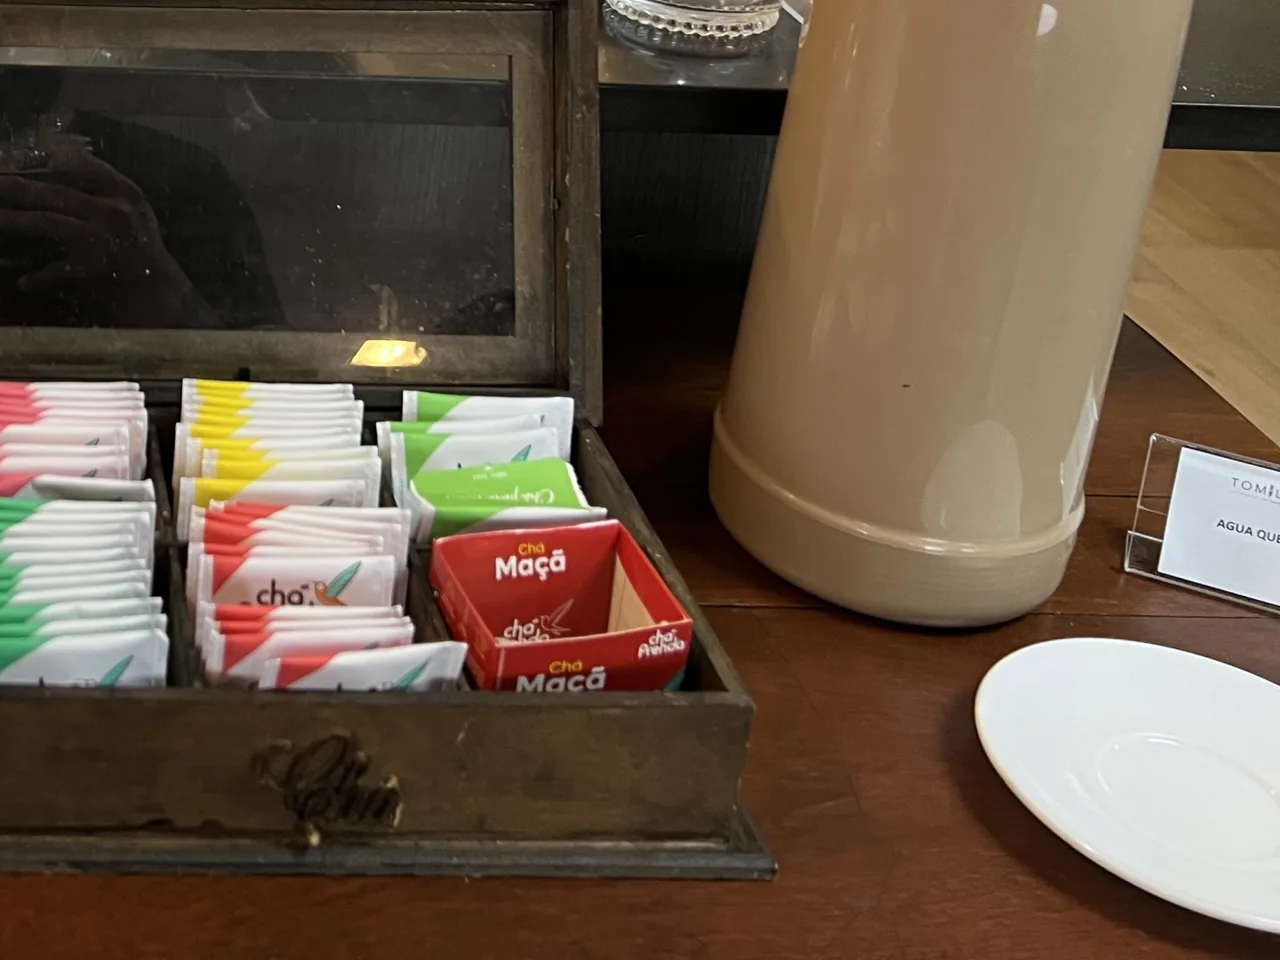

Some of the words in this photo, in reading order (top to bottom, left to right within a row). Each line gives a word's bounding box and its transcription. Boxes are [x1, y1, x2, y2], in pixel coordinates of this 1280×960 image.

[1216, 519, 1253, 537] AGUA
[518, 542, 544, 556] Chá
[495, 549, 567, 581] Maçã
[549, 660, 583, 674] Chá
